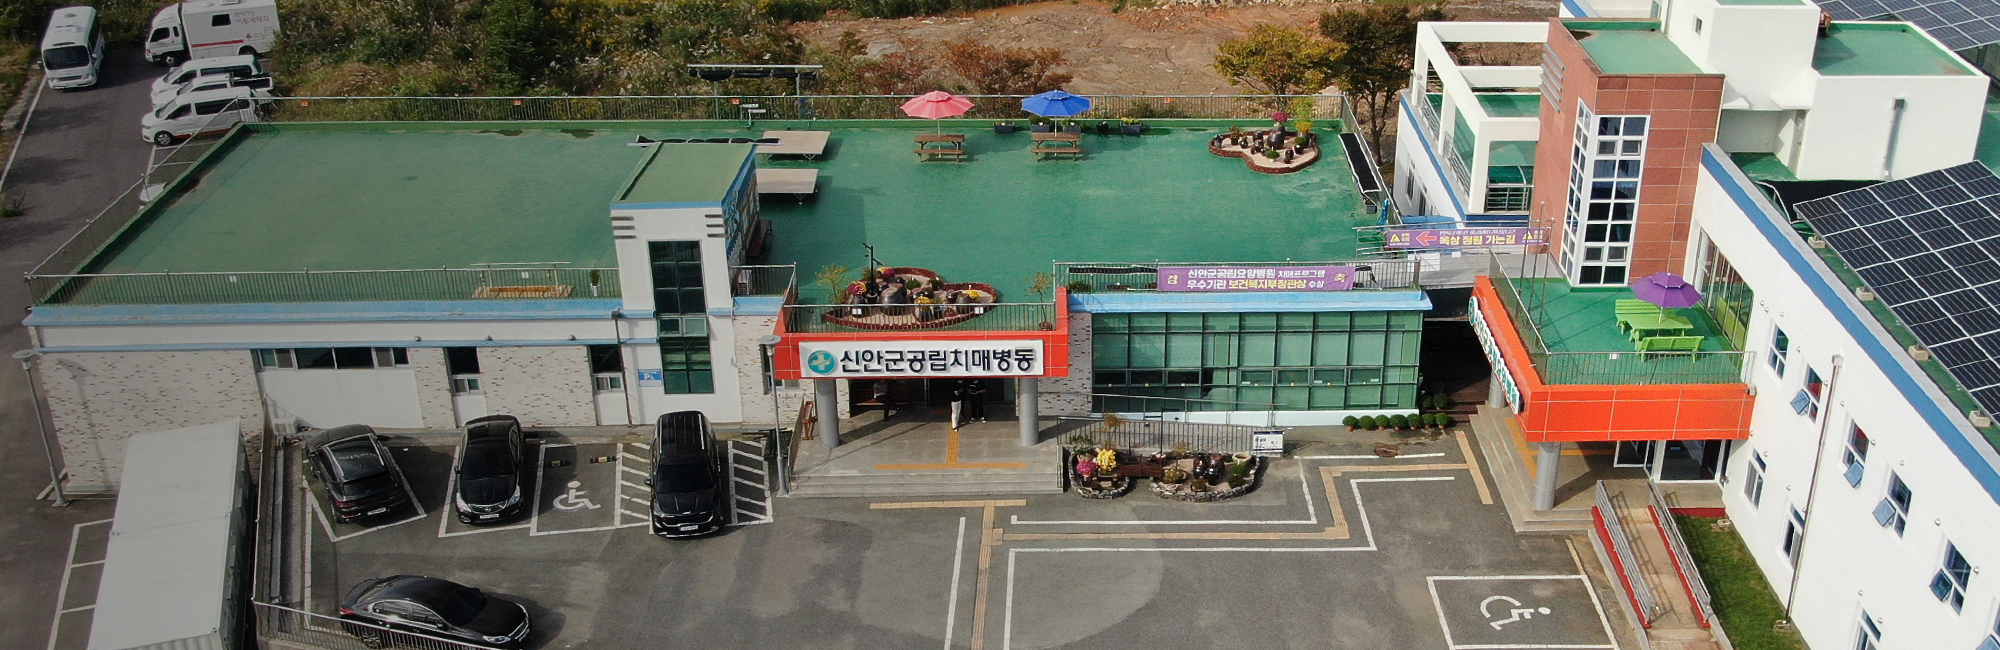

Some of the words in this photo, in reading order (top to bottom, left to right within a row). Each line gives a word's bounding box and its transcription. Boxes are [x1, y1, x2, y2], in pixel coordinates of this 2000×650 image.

[1439, 235, 1460, 246] 옥상
[1462, 235, 1483, 245] 정원
[1485, 234, 1516, 245] 가는길
[1187, 269, 1276, 279] 신안군공립요양병원
[1278, 269, 1326, 278] 치매프로그램
[1187, 279, 1226, 289] 우수기관
[1228, 279, 1306, 289] 보건복지부장관상
[1308, 281, 1325, 289] 수상
[840, 347, 1035, 373] 신안군공립치매병동
